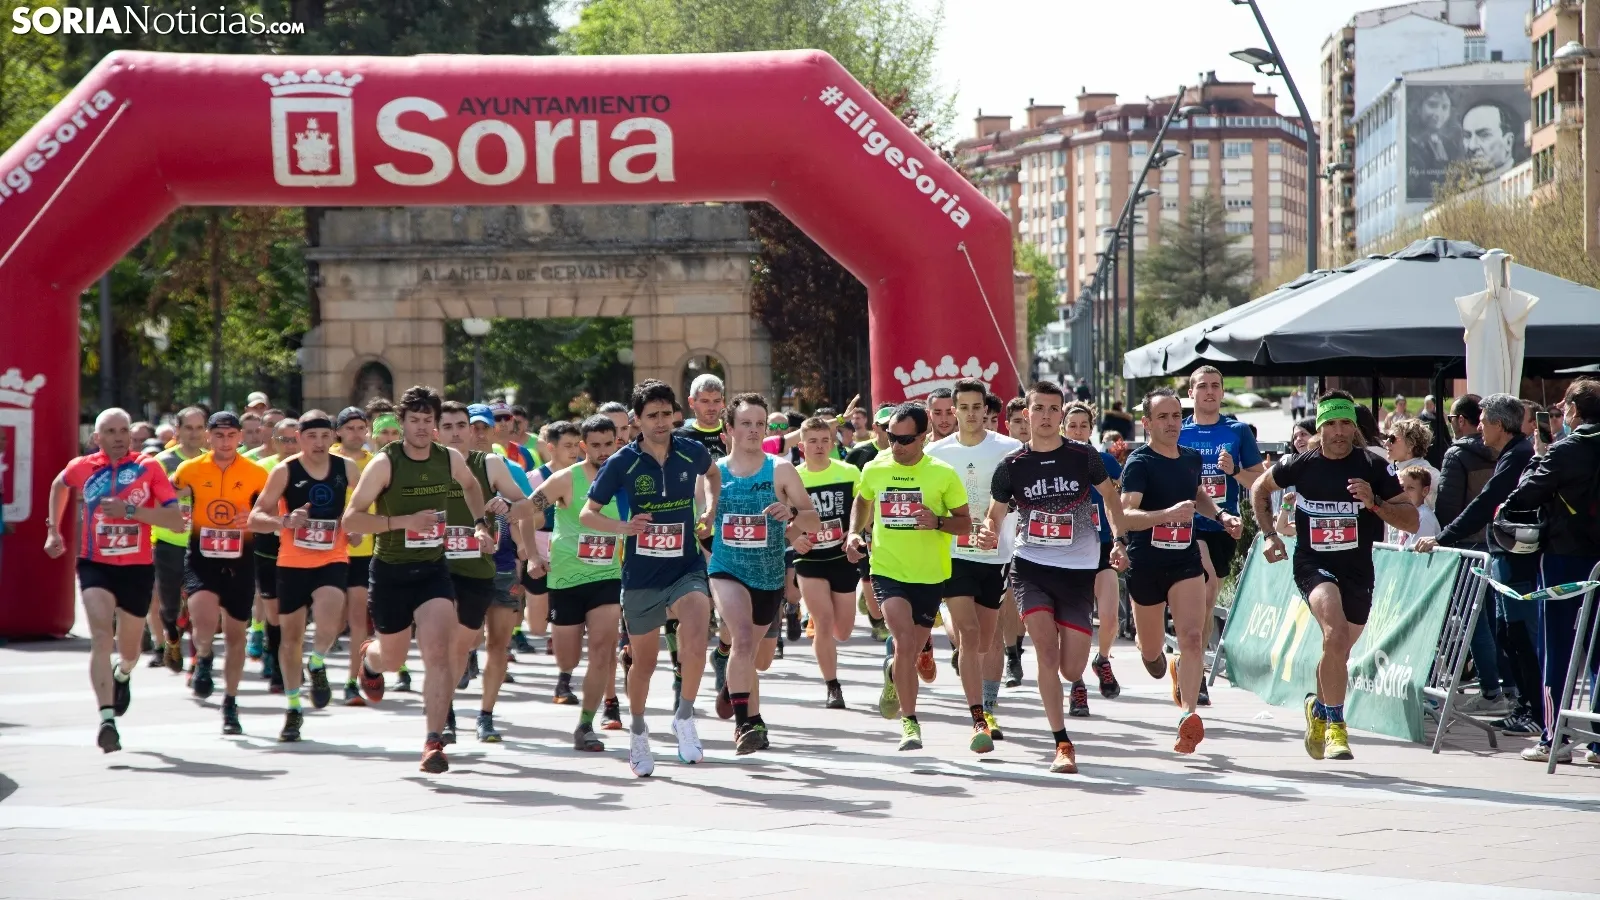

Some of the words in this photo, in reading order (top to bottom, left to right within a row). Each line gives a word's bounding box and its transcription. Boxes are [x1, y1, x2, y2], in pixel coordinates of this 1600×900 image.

[457, 94, 670, 116] AYUNTAMIENTO
[374, 97, 676, 187] Soria
[819, 85, 971, 229] #EligeSoria
[421, 266, 512, 281] ALAMEDA
[516, 268, 536, 281] DE
[540, 263, 648, 280] CERVANTES
[890, 503, 911, 516] 45
[304, 529, 326, 542] 20
[733, 526, 755, 539] 92
[817, 530, 833, 542] 60
[1041, 524, 1060, 537] 13
[1171, 528, 1178, 541] 1
[1323, 529, 1345, 542] 25
[107, 534, 129, 547] 74
[211, 540, 229, 550] 11
[447, 537, 468, 550] 58
[645, 535, 676, 549] 120
[589, 545, 607, 558] 73
[1375, 649, 1413, 700] Soria
